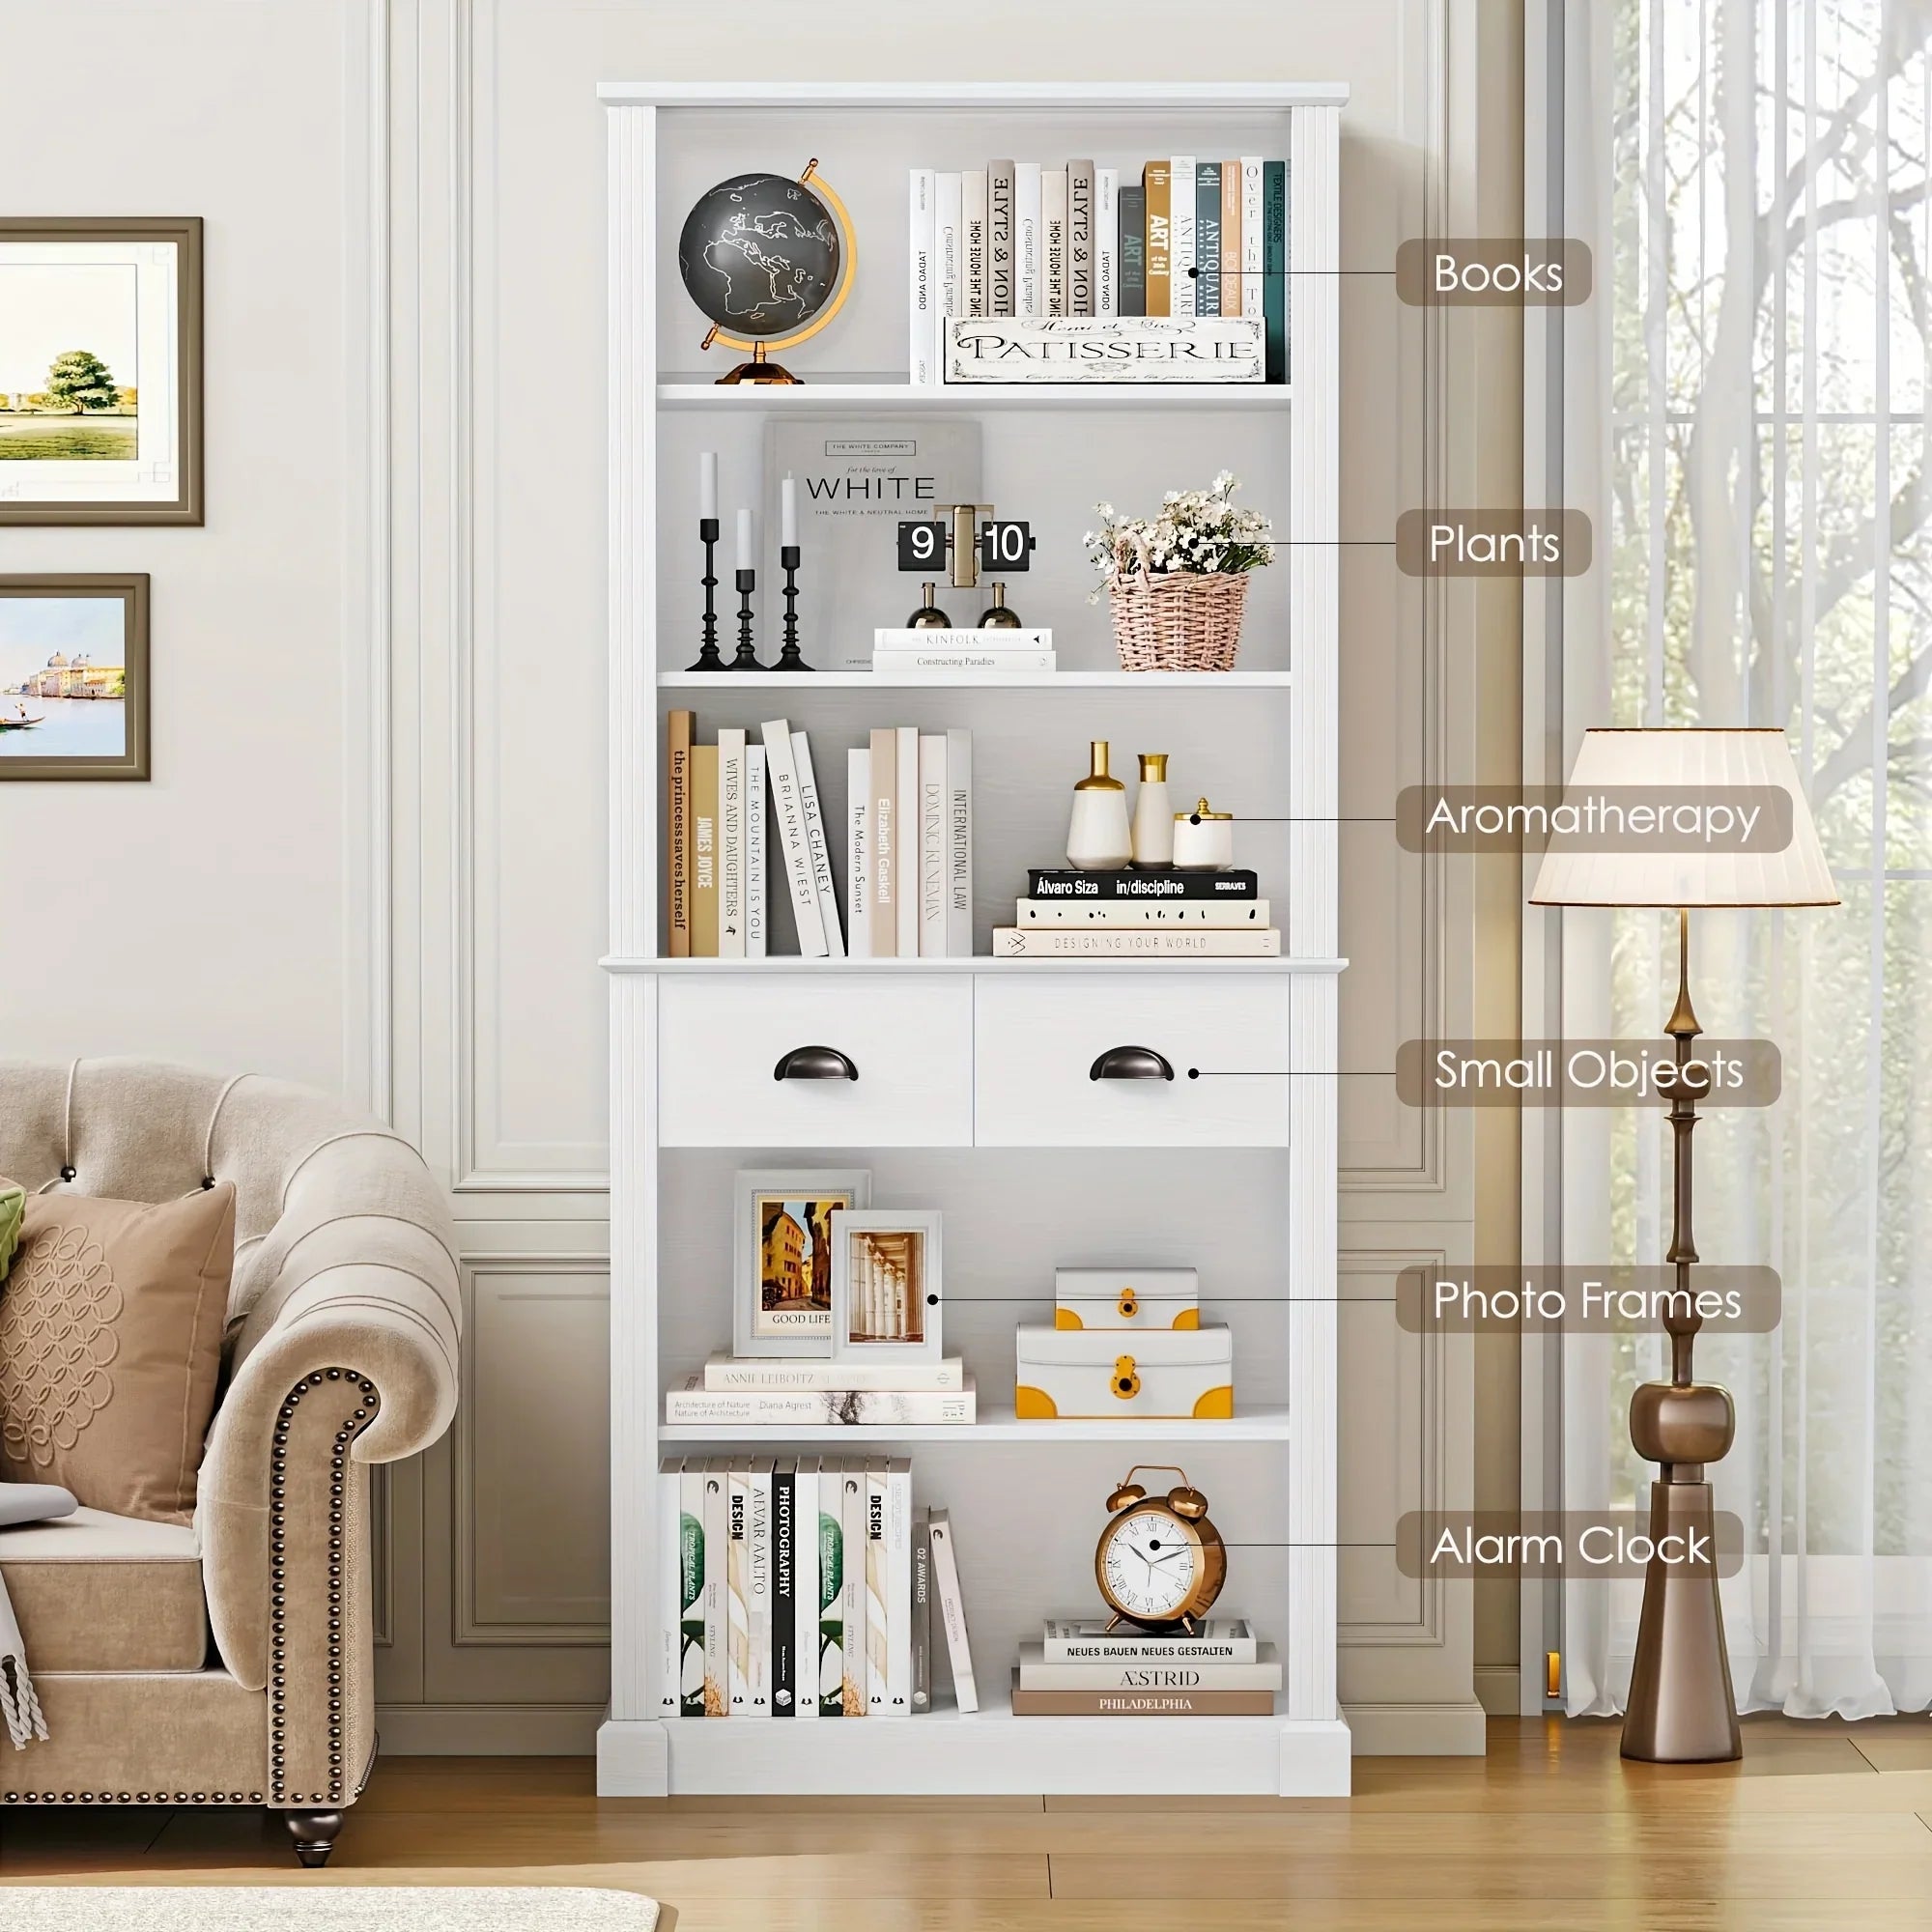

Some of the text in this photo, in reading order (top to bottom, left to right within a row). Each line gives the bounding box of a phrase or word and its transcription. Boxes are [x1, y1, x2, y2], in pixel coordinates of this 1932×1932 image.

[1273, 174, 1282, 243] TEXTILE DESIGNERS
[1124, 234, 1142, 266] ART
[1150, 214, 1169, 251] ART
[956, 335, 1258, 360] PATISSERIE
[807, 478, 935, 499] WHITE
[911, 525, 1023, 561] 9 10
[926, 634, 980, 644] KINFOLK
[917, 657, 995, 667] Constructing Paradies
[672, 750, 686, 930] the princess saves herself
[697, 816, 712, 889] JAMES JOYCE
[726, 758, 738, 917] WIVES AND DAUGHTERS
[750, 767, 760, 939] THE MOUNTAIN IS YOU
[779, 774, 811, 906] BRIANNA WIEST
[801, 785, 831, 893] LISA CHANEY
[879, 798, 891, 903] Elizabeth Gaskell
[953, 790, 966, 910] INTERNATIONAL LAW
[854, 805, 865, 913] The Modern Sunset
[1037, 877, 1073, 894] Álvaro
[1075, 880, 1099, 894] Siza
[1116, 880, 1184, 897] in/discipline
[1055, 938, 1207, 949] DESIGNING YOUR WORLD
[772, 1314, 831, 1324] GOOD LIFE
[724, 1374, 755, 1384] ANNIE
[760, 1401, 783, 1409] Diana
[785, 1401, 812, 1412] Agrest
[732, 1495, 743, 1540] DESIGN
[870, 1495, 881, 1540] DESIGN
[753, 1488, 765, 1595] ALVAR AALTO
[779, 1486, 790, 1597] PHOTOGRAPHY
[917, 1562, 926, 1604] AWARDS
[1067, 1647, 1233, 1656] NEUES BAUEN NEUES GESTALTEN
[1099, 1698, 1193, 1710] PHILADELPHIA
